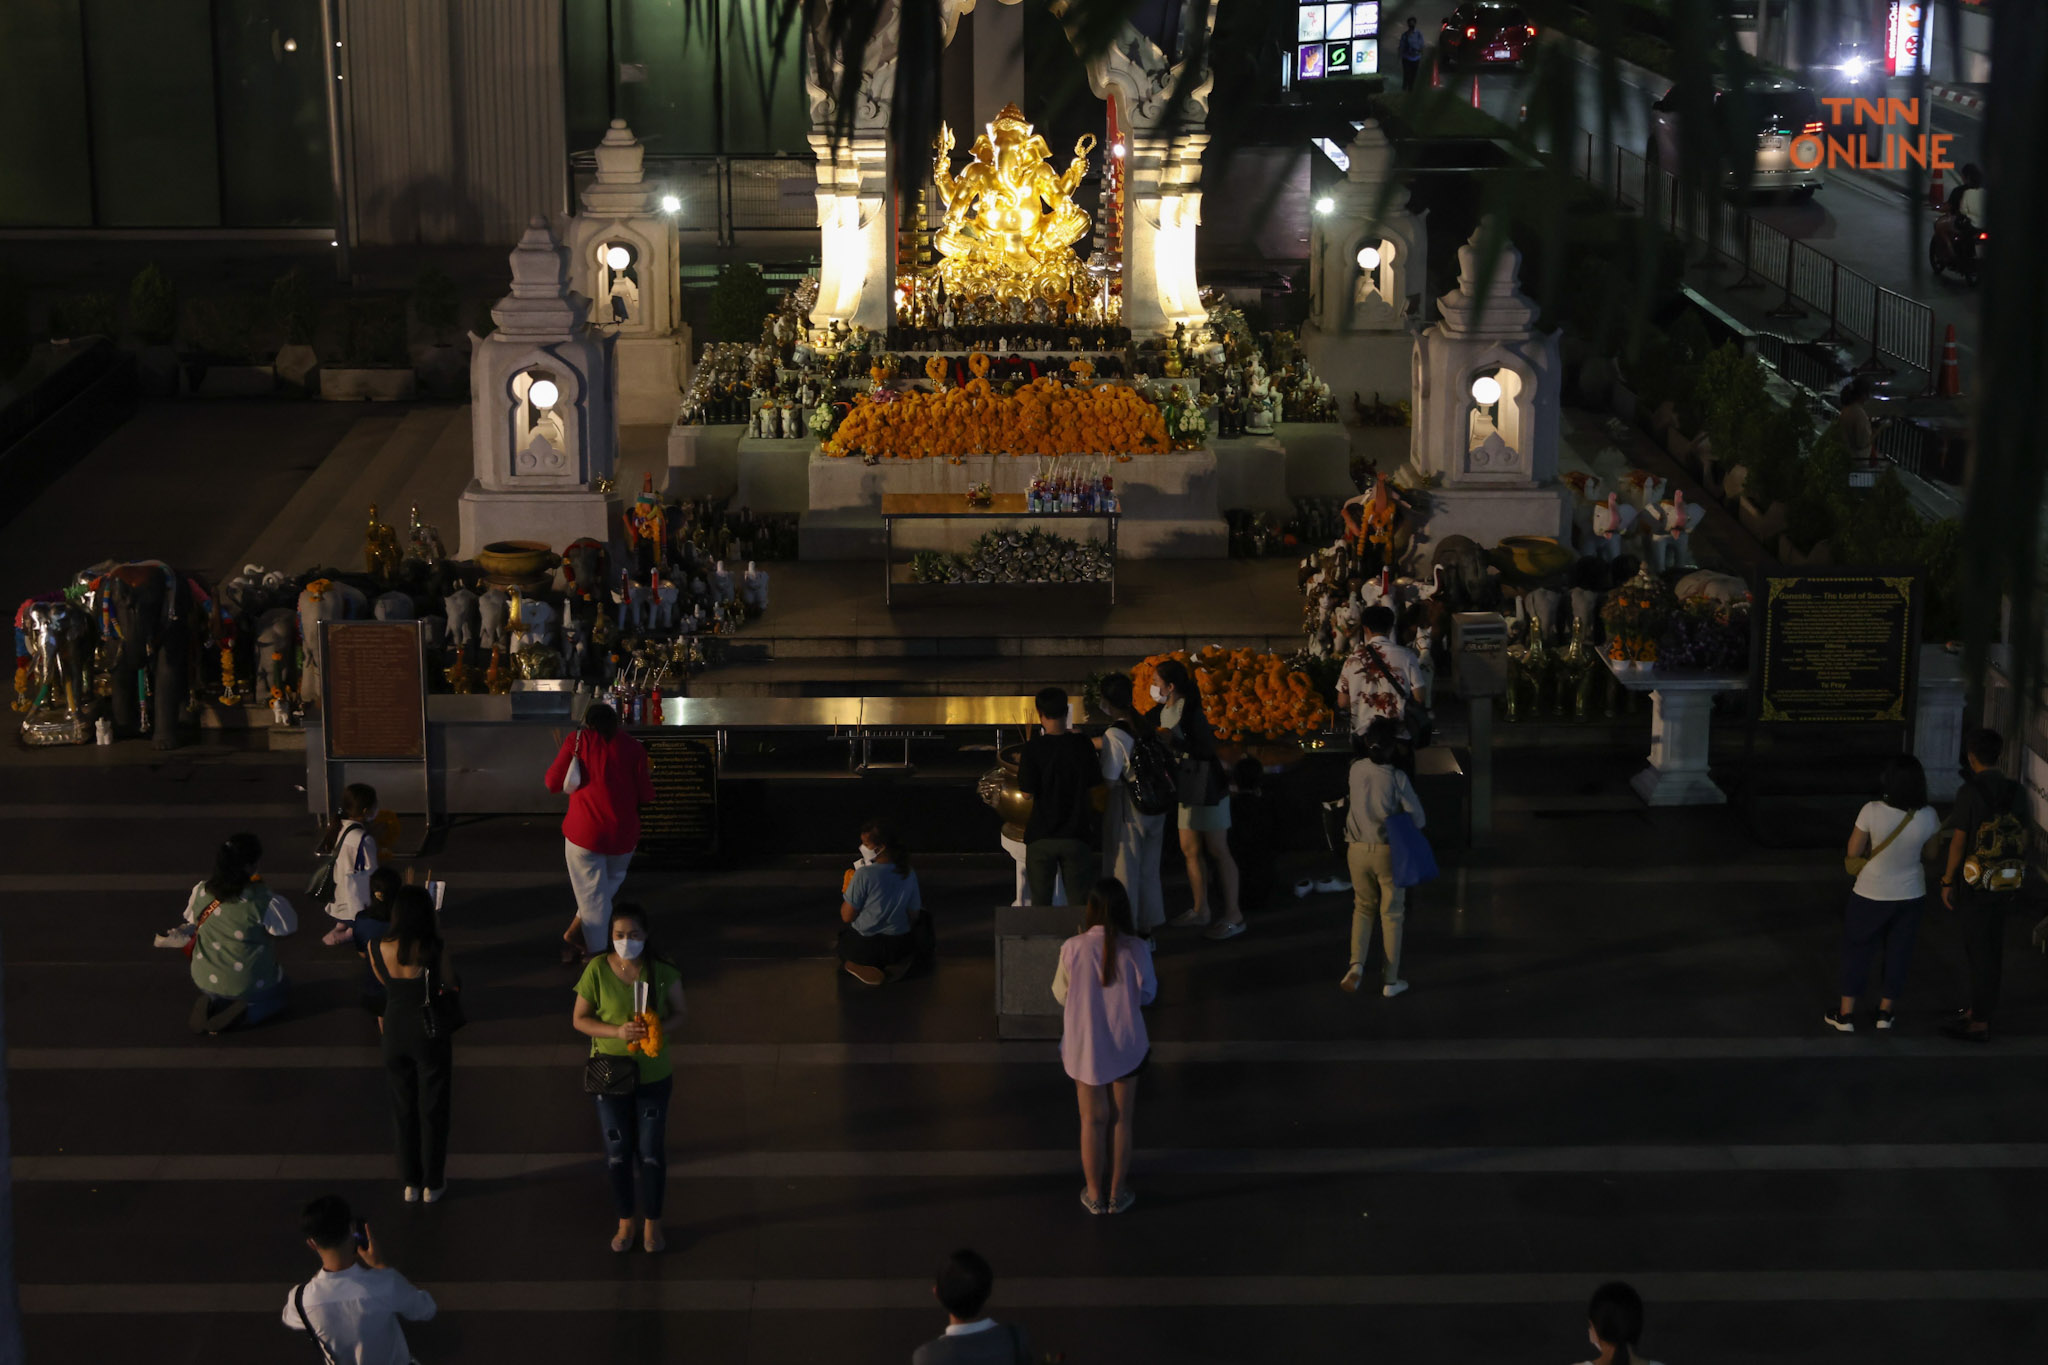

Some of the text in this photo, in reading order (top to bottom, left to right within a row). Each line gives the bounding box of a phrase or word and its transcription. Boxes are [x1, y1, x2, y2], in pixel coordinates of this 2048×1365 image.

[1356, 50, 1375, 63] B2S
[1823, 592, 1837, 600] The
[1839, 592, 1857, 600] Lord
[1858, 592, 1866, 600] of
[1867, 591, 1899, 599] Success
[1830, 682, 1847, 690] Pray
